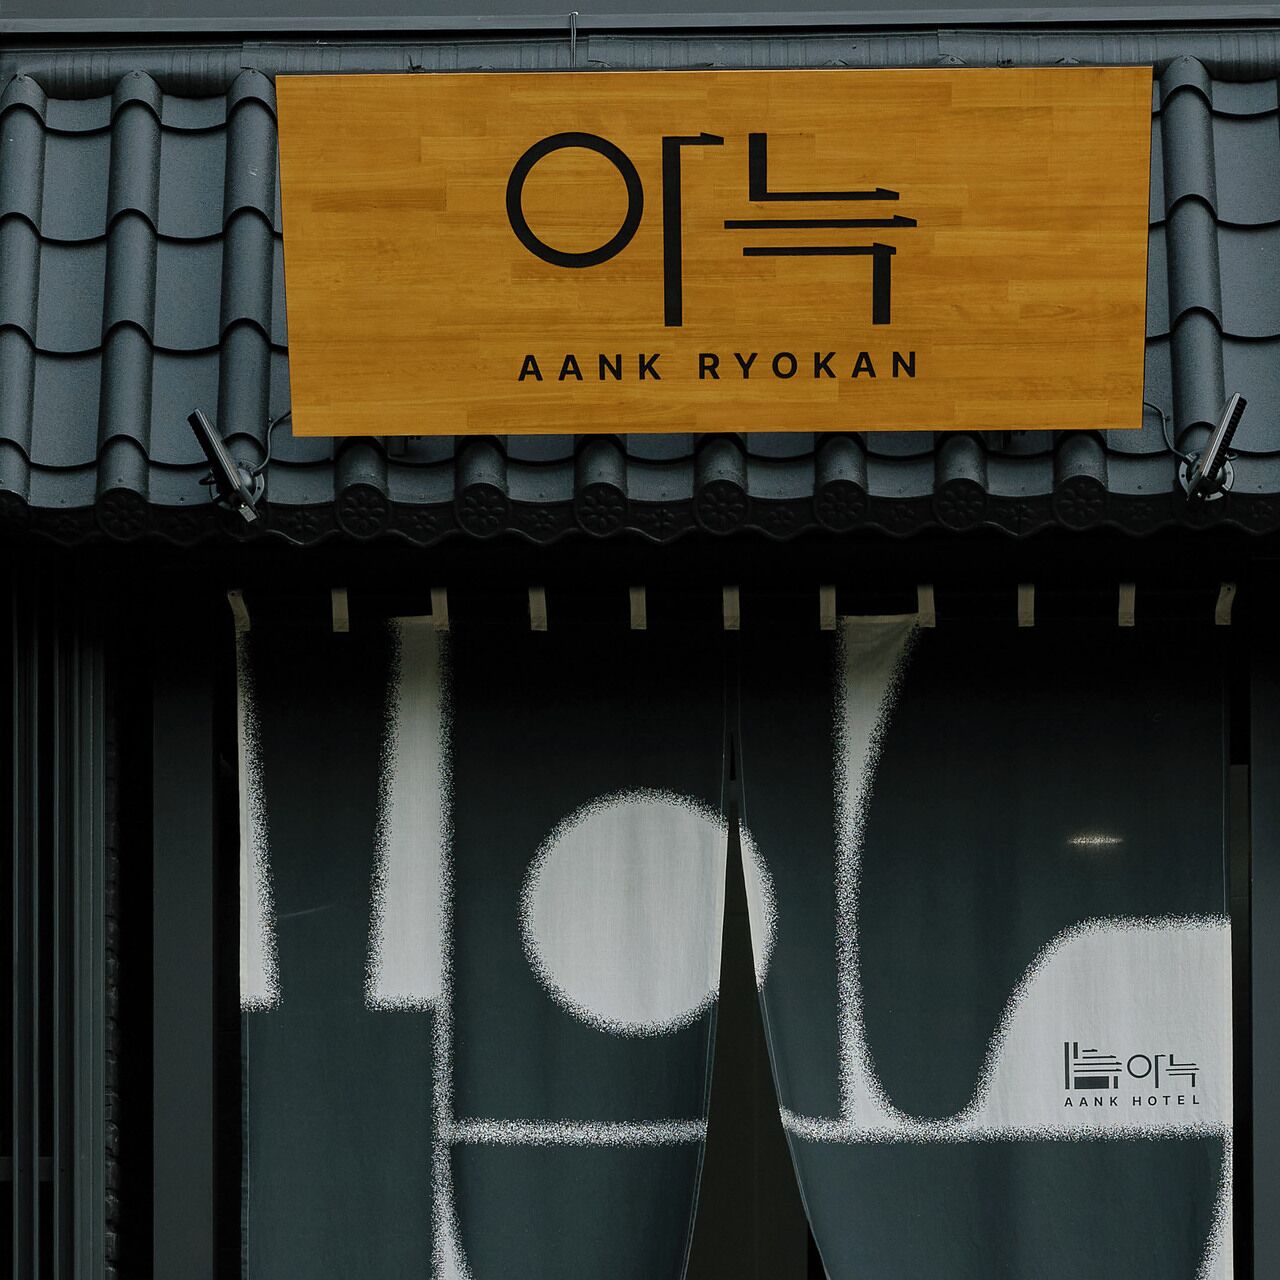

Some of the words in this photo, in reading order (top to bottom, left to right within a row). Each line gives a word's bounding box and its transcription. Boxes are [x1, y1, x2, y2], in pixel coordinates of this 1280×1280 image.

[517, 353, 664, 382] AANK
[698, 351, 918, 381] RYOKAN
[1064, 1096, 1119, 1108] AANK
[1132, 1094, 1200, 1107] HOTEL
